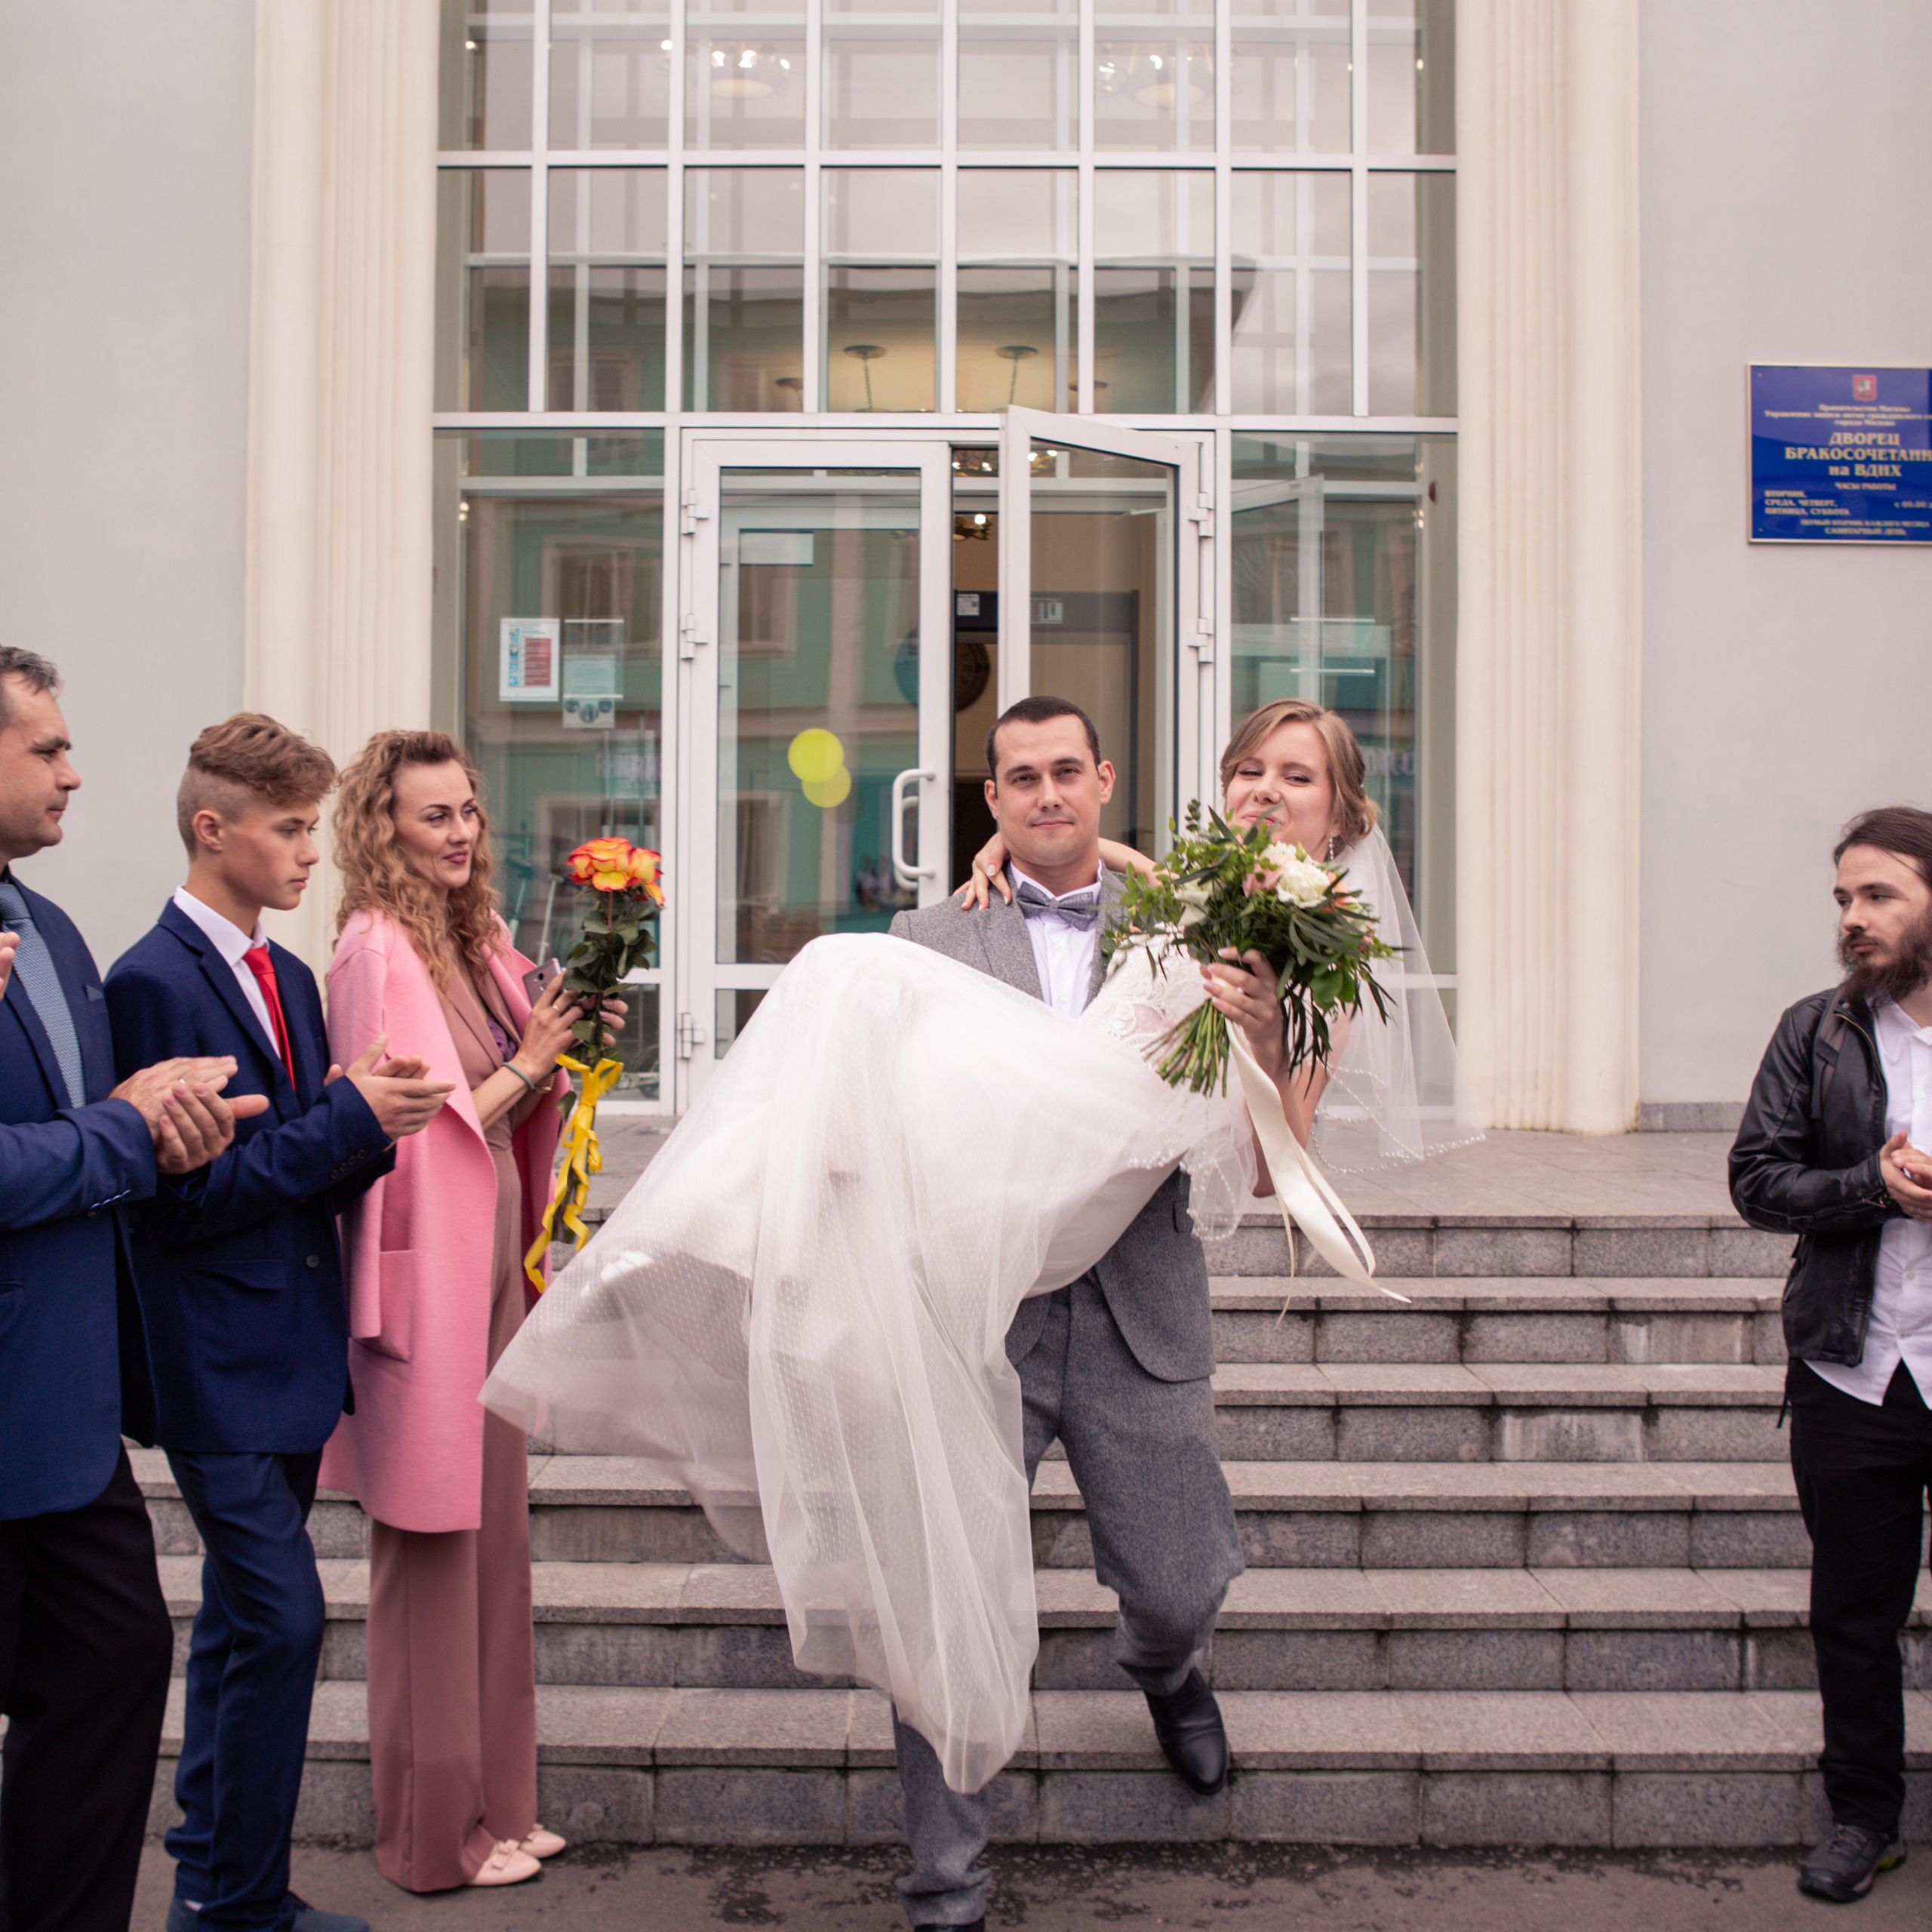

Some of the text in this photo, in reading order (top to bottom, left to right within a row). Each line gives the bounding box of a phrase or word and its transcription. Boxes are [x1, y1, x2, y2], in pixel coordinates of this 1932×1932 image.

[1829, 432, 1900, 446] ДВОРЕЦ
[1829, 463, 1903, 478] на ВДНХ
